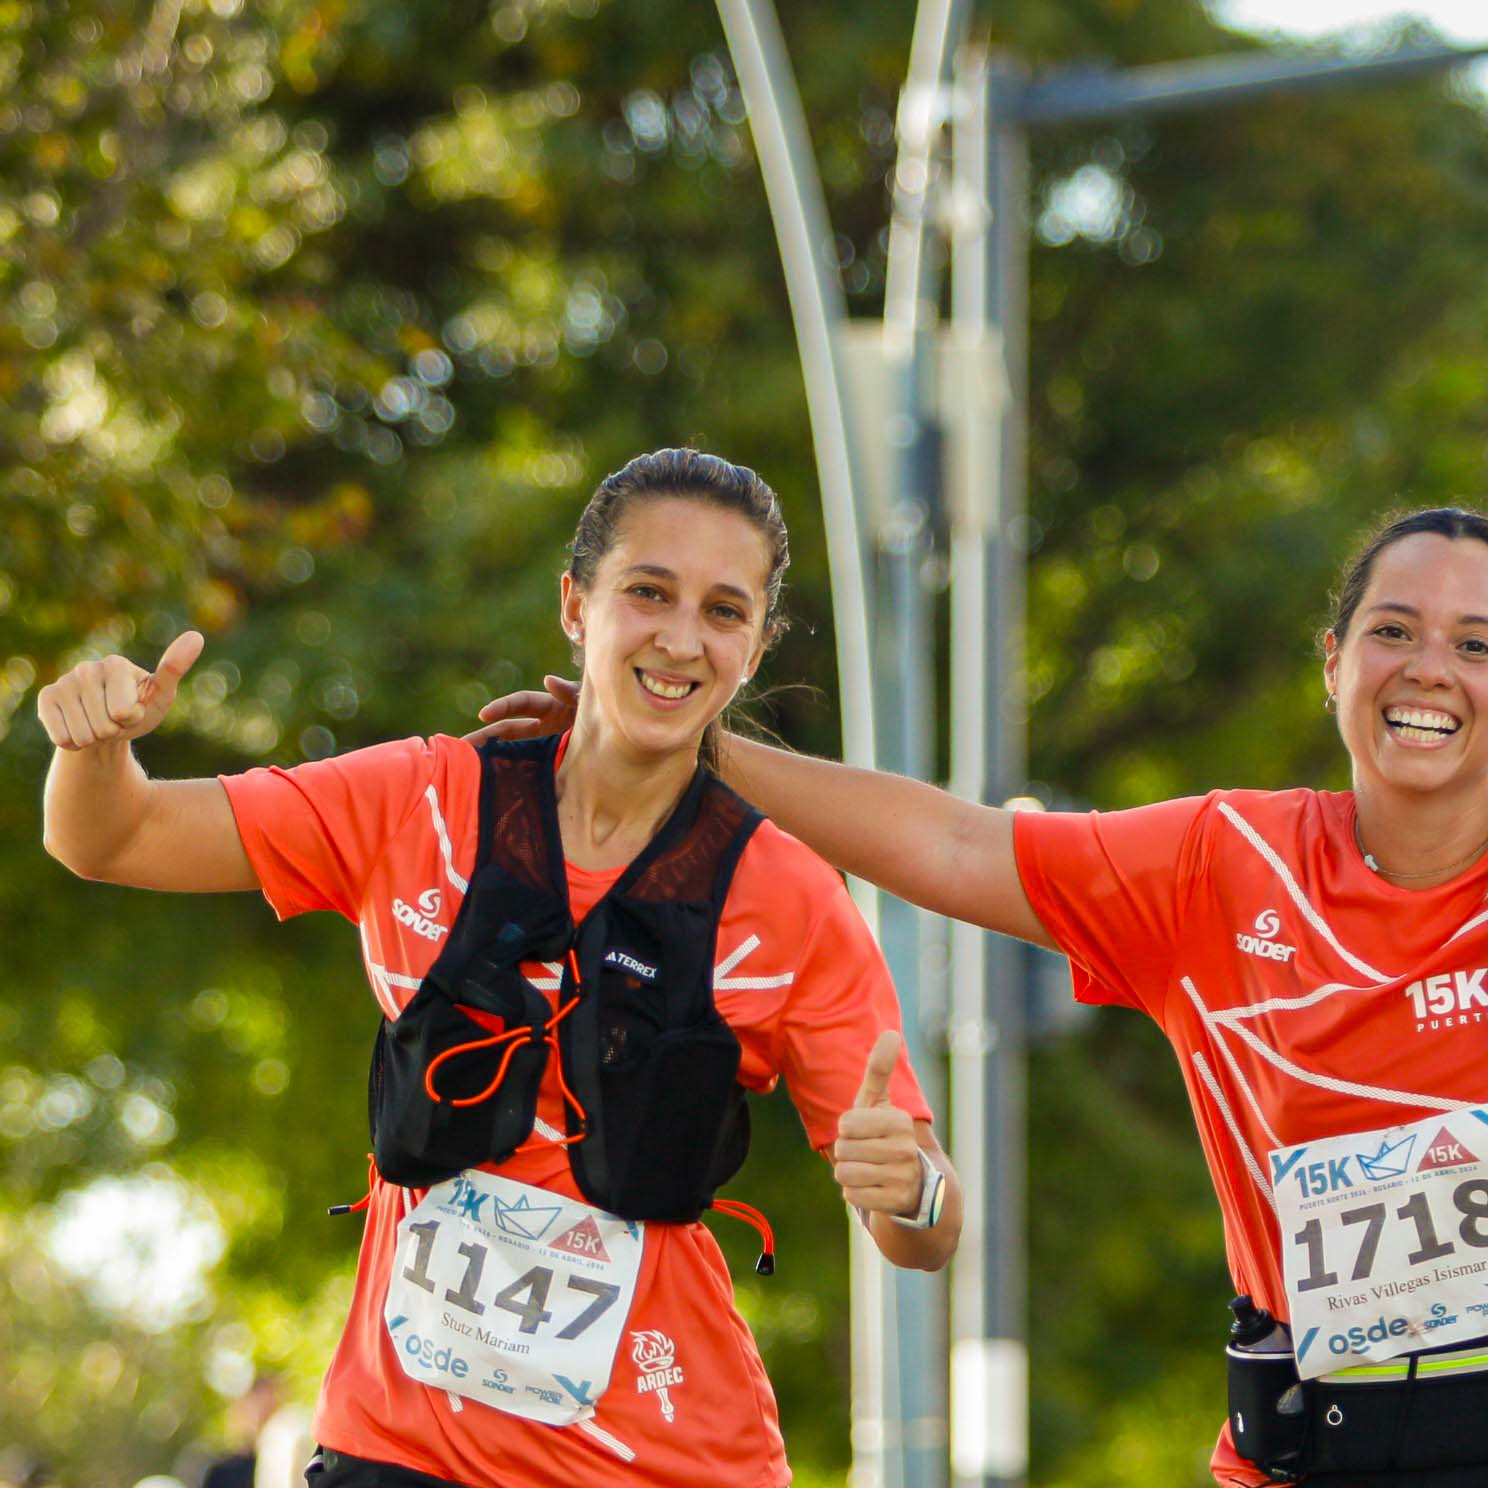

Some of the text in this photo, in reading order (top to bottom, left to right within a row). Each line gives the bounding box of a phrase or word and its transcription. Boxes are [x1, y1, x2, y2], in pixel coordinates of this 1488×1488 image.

[618, 952, 658, 978] TERREX
[1428, 1143, 1463, 1164] 15K
[1294, 1156, 1353, 1199] 15K
[566, 1230, 599, 1254] 15K
[403, 1220, 621, 1340] 1147
[1327, 1260, 1488, 1311] Rivas Villegas Isismar
[441, 1311, 530, 1355] Stutz Mariam
[1328, 1315, 1409, 1355] osde
[405, 1333, 469, 1378] osde
[637, 1366, 684, 1394] ARDEC
